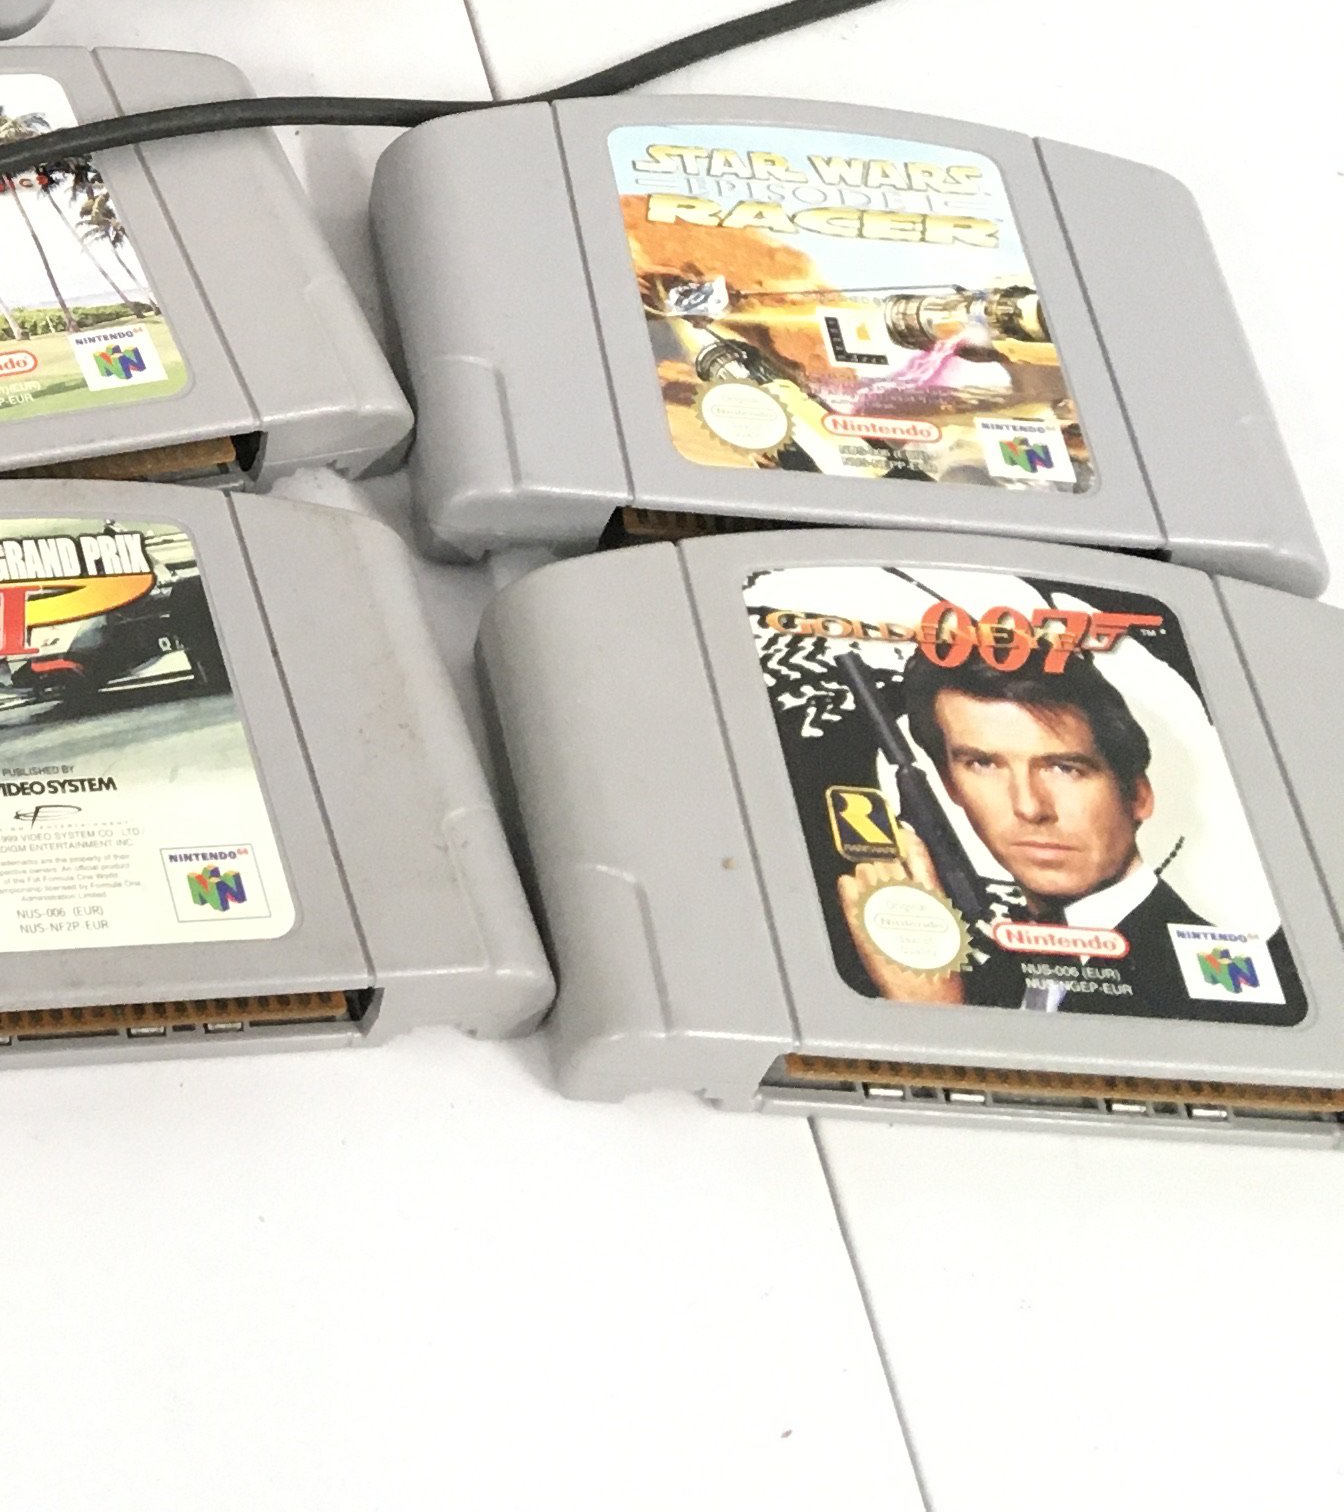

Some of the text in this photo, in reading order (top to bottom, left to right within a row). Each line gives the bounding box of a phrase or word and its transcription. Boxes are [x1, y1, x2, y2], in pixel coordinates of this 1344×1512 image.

[632, 144, 992, 195] STAR WARS
[646, 193, 1000, 248] RACER
[832, 418, 932, 439] Nintendo
[80, 532, 152, 576] PRIX
[920, 600, 1092, 675] 007
[2, 765, 75, 777] PUBLISHED BY
[48, 777, 118, 796] SYSTEM
[73, 906, 104, 918] (EUR)
[1006, 928, 1118, 951] Nintendo
[1082, 964, 1121, 981] (EUR)
